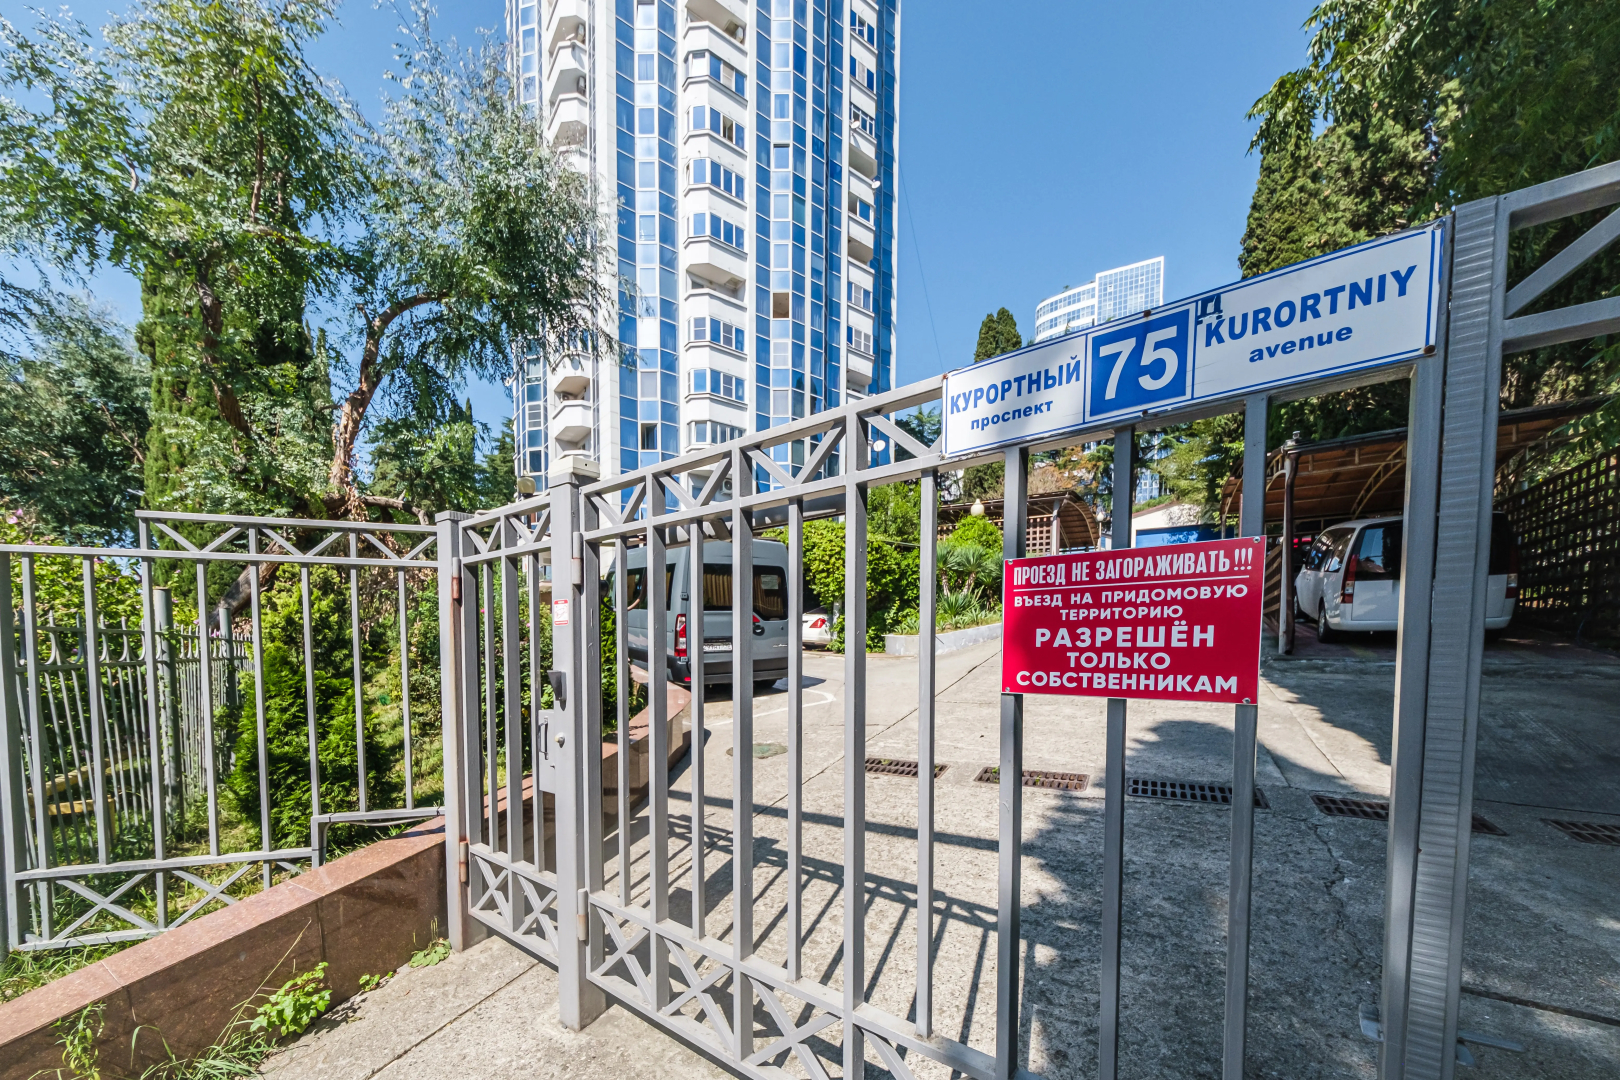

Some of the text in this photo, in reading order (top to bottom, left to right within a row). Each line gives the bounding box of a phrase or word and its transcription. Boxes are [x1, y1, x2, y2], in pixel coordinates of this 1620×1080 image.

[1204, 264, 1418, 348] KURORTNIY
[1248, 325, 1354, 363] avenue
[1098, 325, 1179, 400] 75
[949, 354, 1082, 415] КУРОРТНЫЙ
[970, 399, 1054, 431] проспект
[1013, 563, 1066, 586] ПРОЕЗД
[1071, 561, 1091, 582] НЕ
[1013, 583, 1249, 608] ВЪЕЗД НА ПРИДОМОВУЮ
[1059, 604, 1184, 622] ТЕРРИТОРИЮ
[1035, 620, 1215, 648] РАЗРЕШЁН
[1066, 651, 1171, 670] ТОЛЬКО
[1015, 670, 1238, 694] СОБСТВЕННИКАМ
